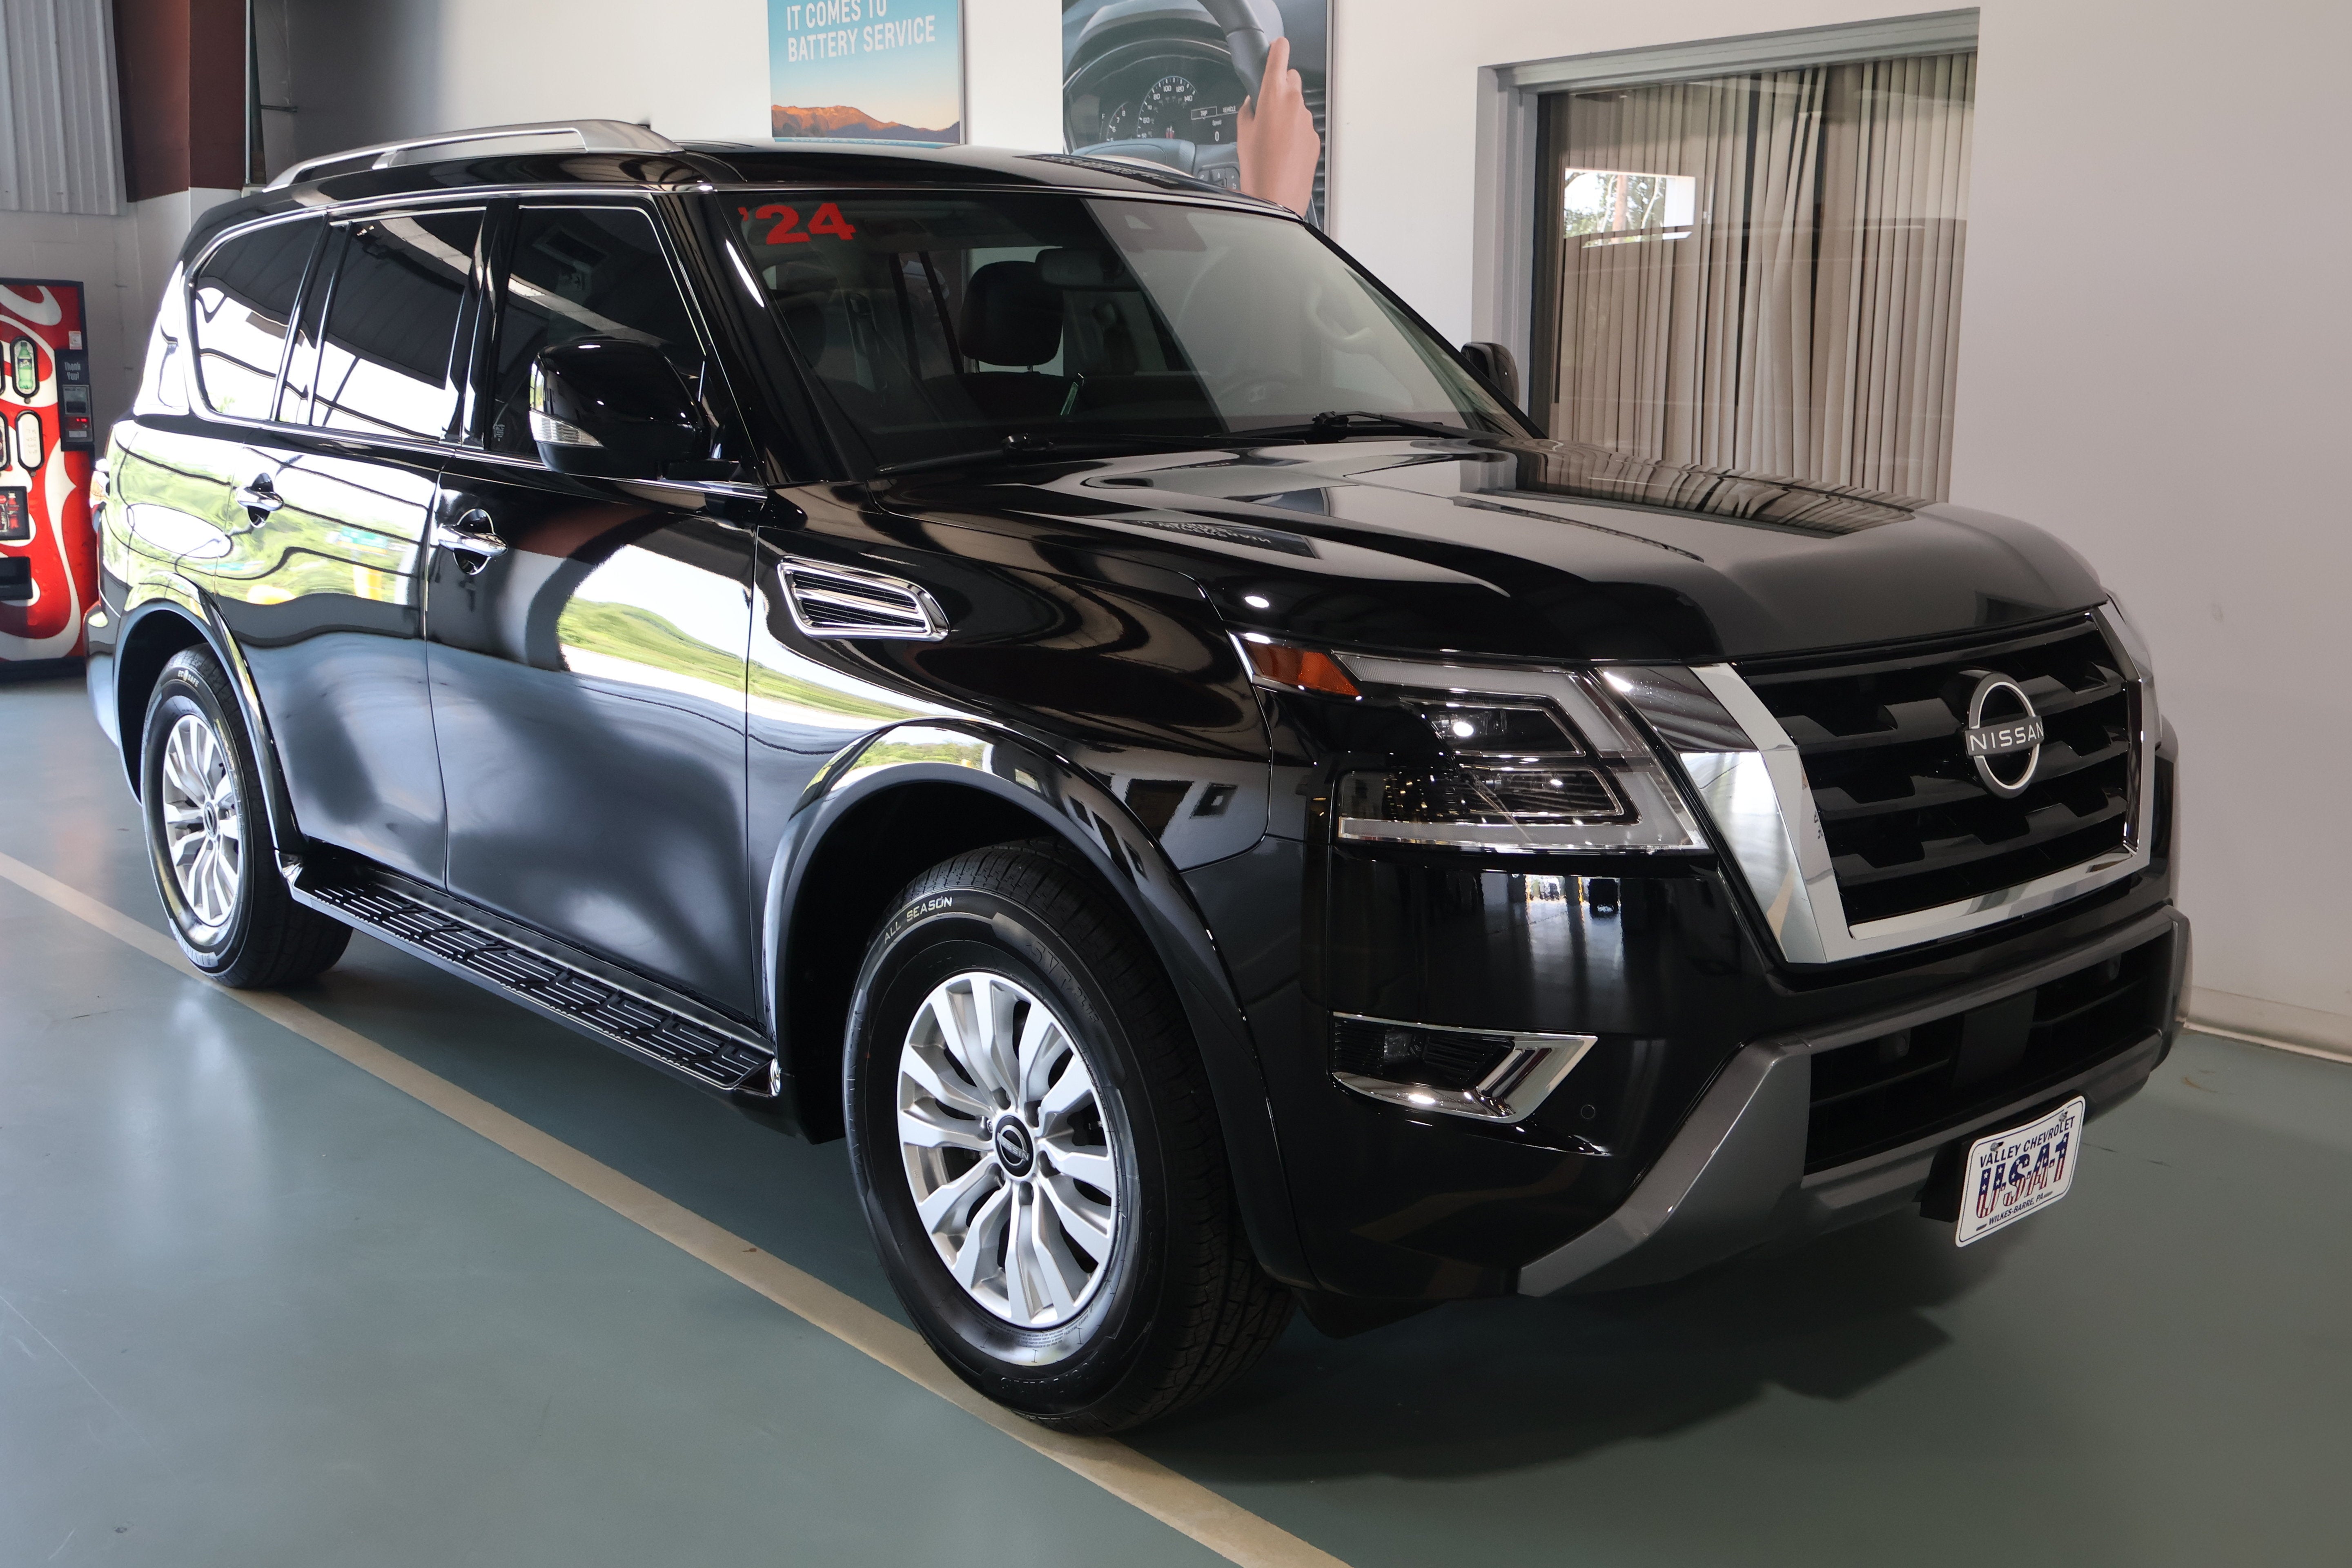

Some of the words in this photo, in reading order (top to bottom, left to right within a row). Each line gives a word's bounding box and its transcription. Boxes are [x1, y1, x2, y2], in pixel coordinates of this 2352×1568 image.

[786, 5, 801, 31] IT
[806, 0, 861, 29] COMES
[869, 0, 886, 18] TO
[788, 28, 858, 62] BATTERY
[863, 15, 935, 52] SERVICE
[1215, 131, 1220, 142] 0
[1969, 721, 2044, 751] NISSAN
[884, 921, 902, 944] ALL
[906, 896, 953, 922] SEASON
[1980, 1143, 2021, 1168] VALLEY
[2023, 1116, 2075, 1152] CHEVROLET
